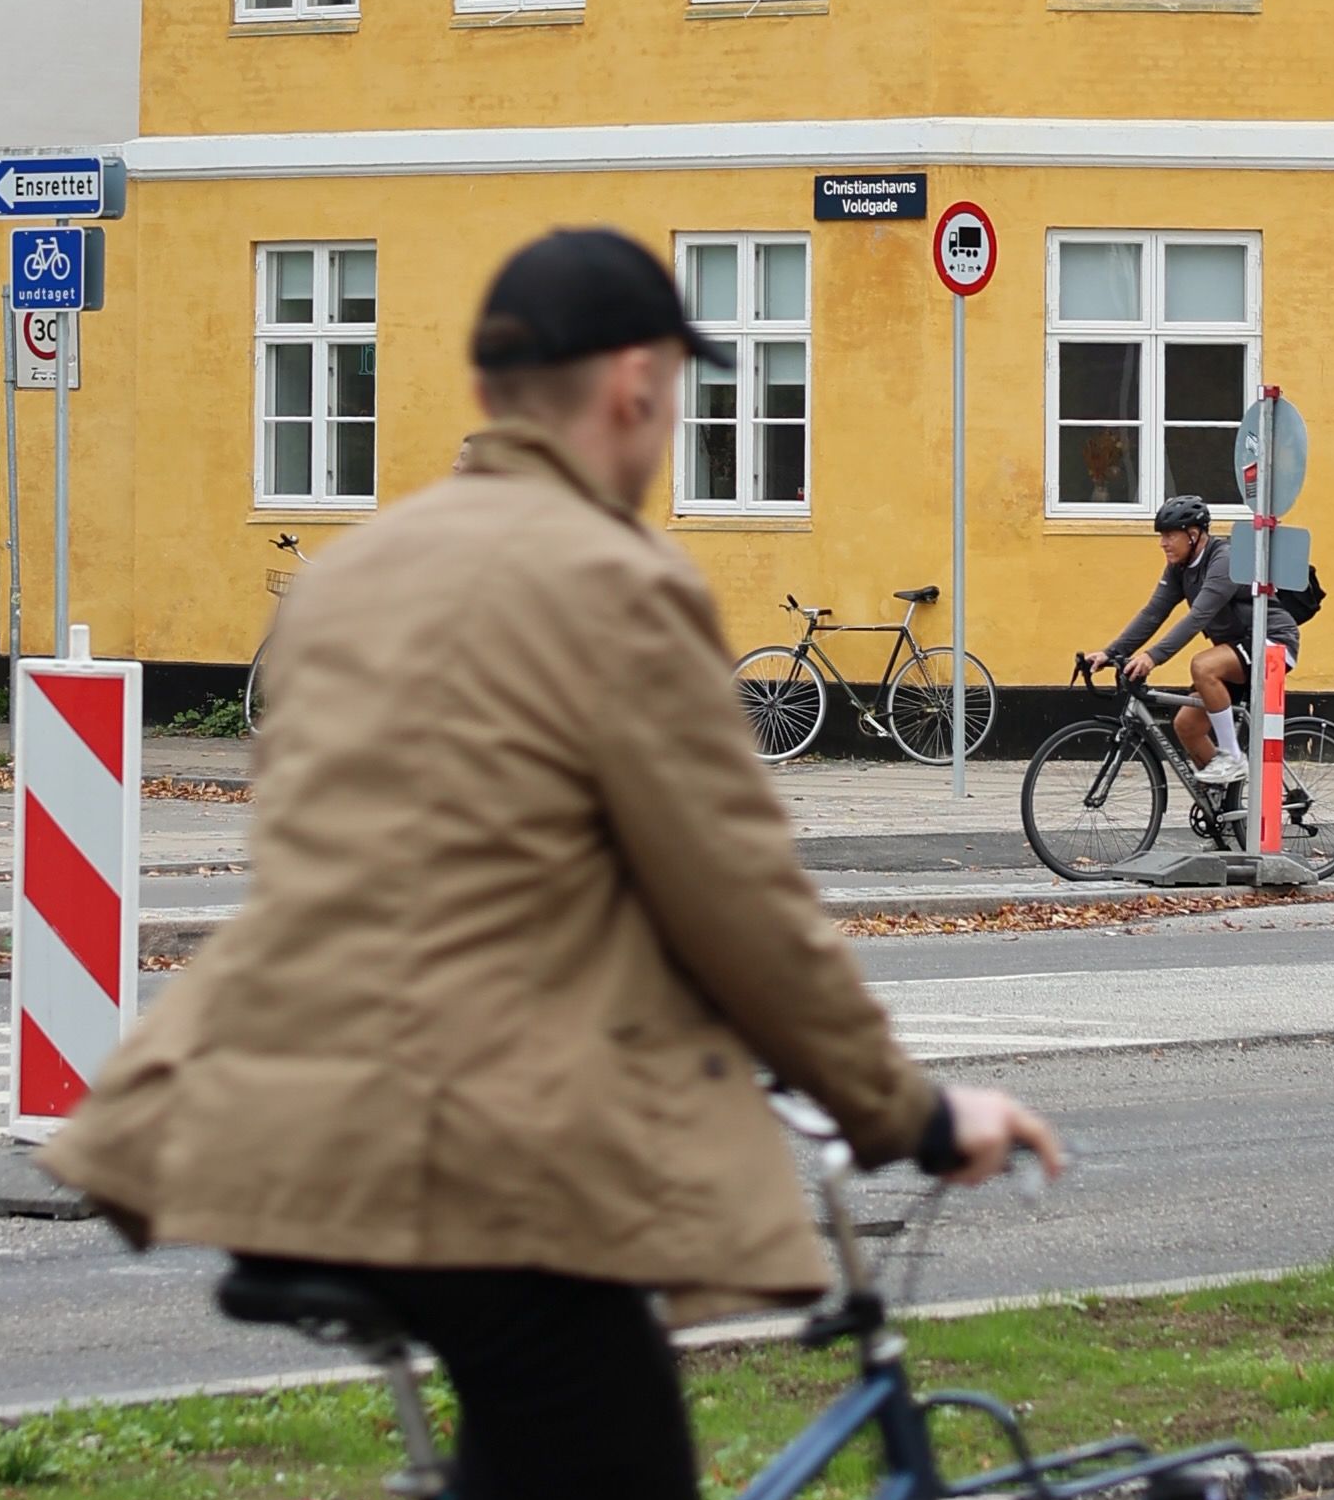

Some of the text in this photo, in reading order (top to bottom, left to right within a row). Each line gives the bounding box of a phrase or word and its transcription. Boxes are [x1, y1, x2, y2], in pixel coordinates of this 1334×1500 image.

[15, 175, 93, 197] Ensrettet
[823, 179, 917, 196] Christianshavns
[842, 199, 898, 216] Voldgade
[956, 264, 966, 273] 12
[19, 287, 76, 302] undtaget
[34, 318, 57, 342] 30
